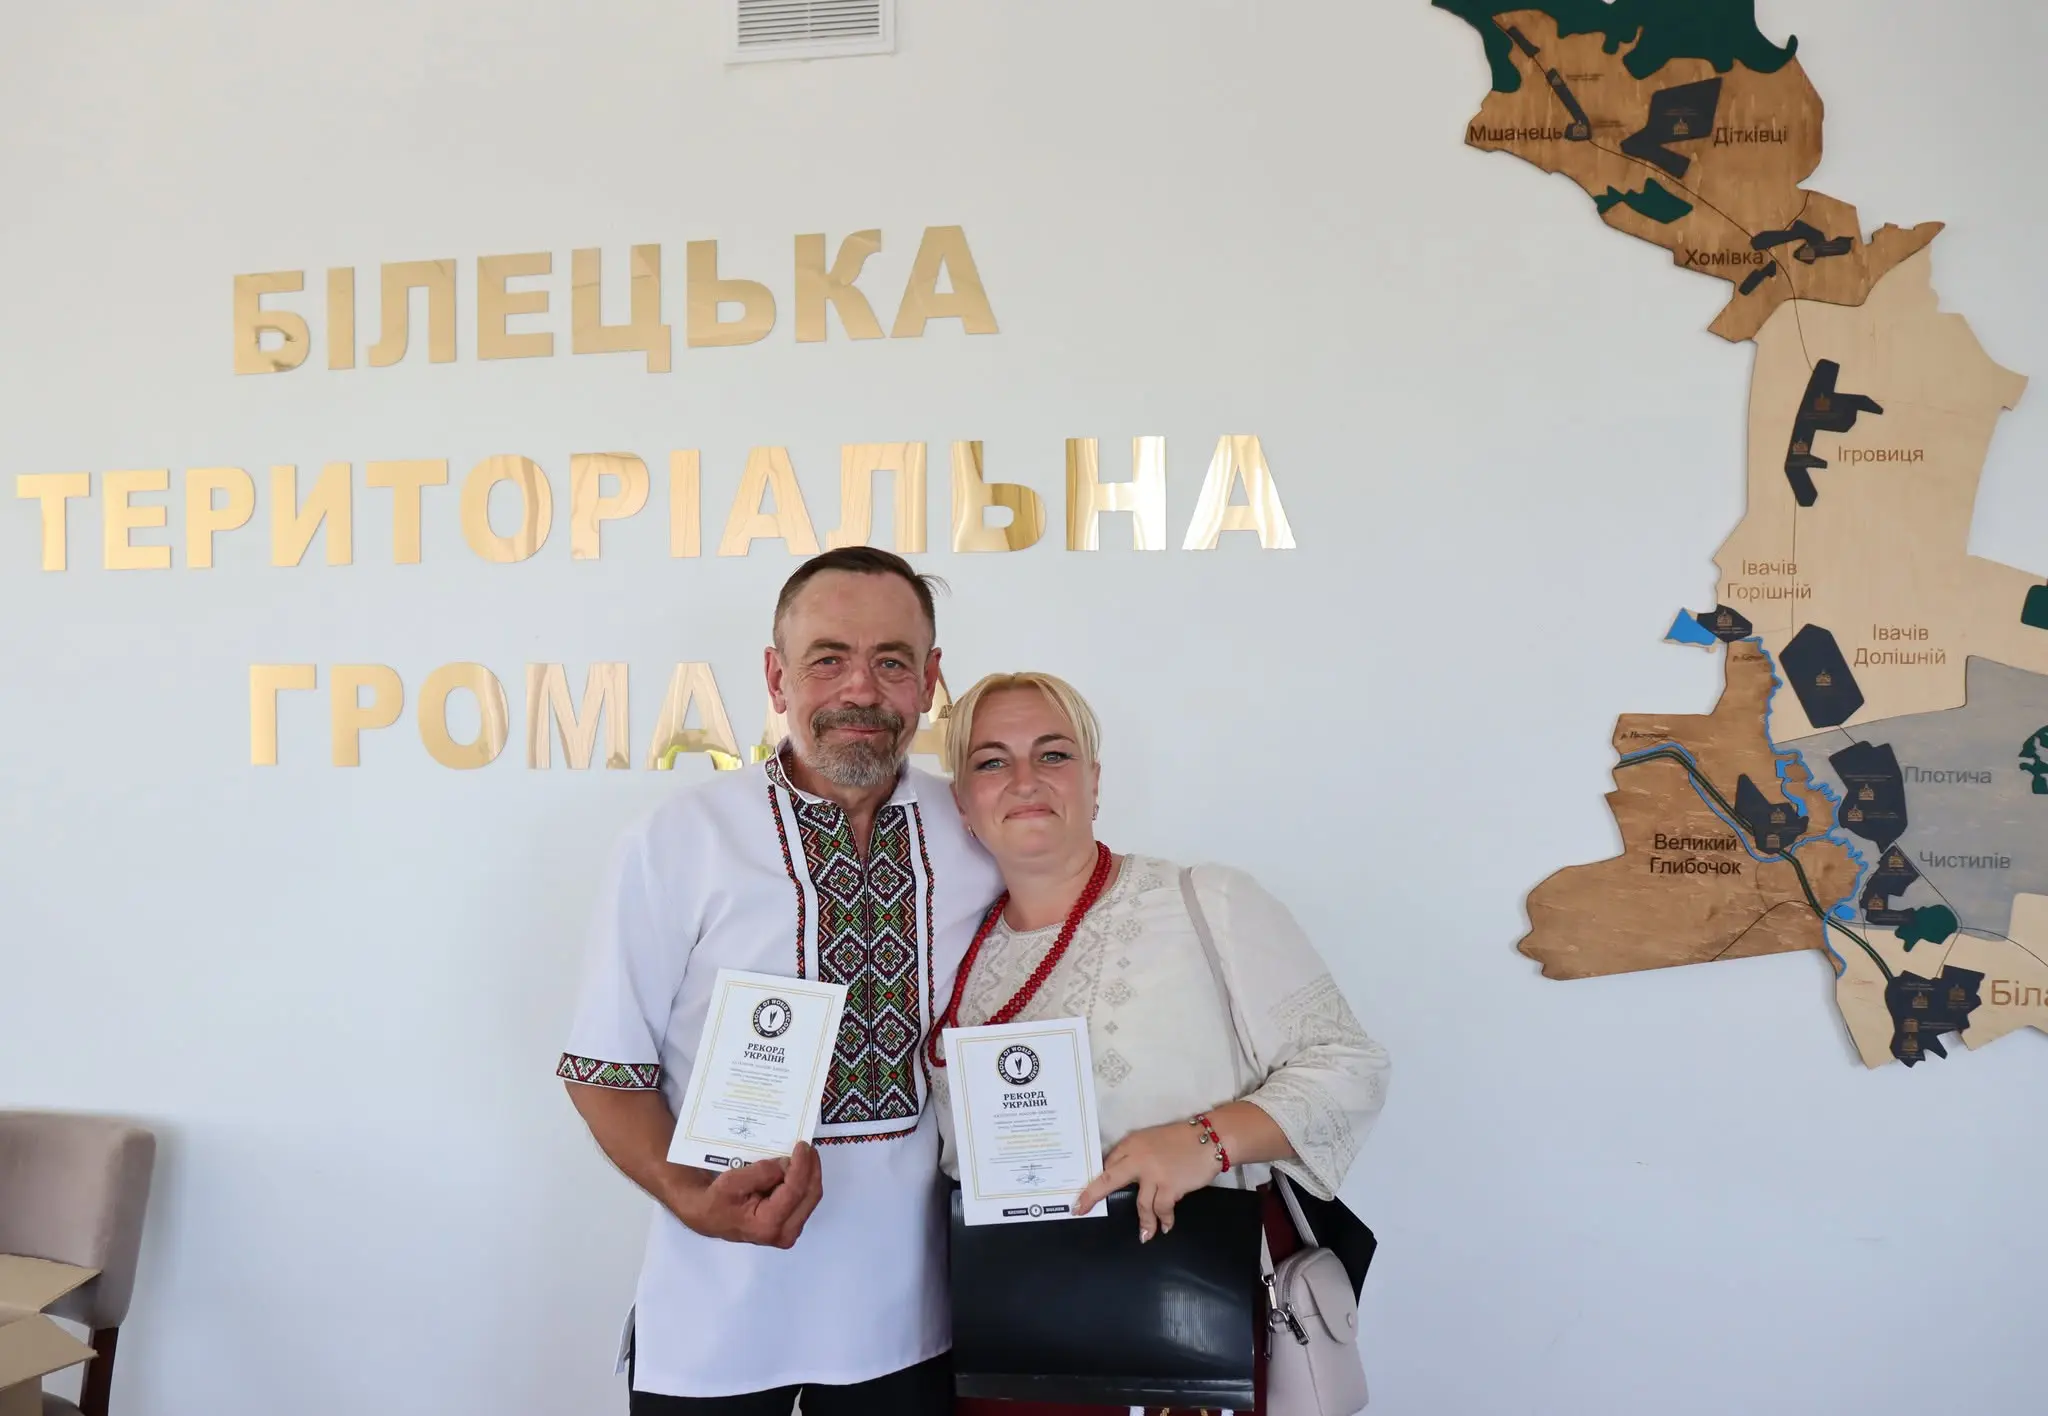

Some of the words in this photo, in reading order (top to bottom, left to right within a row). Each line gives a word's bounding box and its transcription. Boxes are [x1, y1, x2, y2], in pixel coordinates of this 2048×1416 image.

[1470, 124, 1563, 142] Мшанець
[1714, 125, 1788, 145] Дітківці
[1685, 248, 1764, 267] Хомівка
[233, 225, 1000, 375] БІЛЕЦЬКА
[1838, 445, 1924, 466] Ігровиця
[16, 435, 1296, 571] ТЕРИТОРІАЛЬНА
[1742, 559, 1798, 576] Івачів
[1727, 582, 1812, 603] Горішній
[1873, 624, 1929, 641] Івачів
[1854, 648, 1946, 667] Долішній
[1905, 765, 1992, 784] Плотича
[1654, 834, 1737, 852] Великий
[1650, 858, 1741, 876] Глибочок
[1919, 851, 2012, 869] Чистилів
[743, 1051, 785, 1064] УКРАЇНИ
[747, 1043, 785, 1056] РЕКОРД
[1002, 1099, 1048, 1110] УКРАЇНИ
[1003, 1090, 1045, 1101] РЕКОРД
